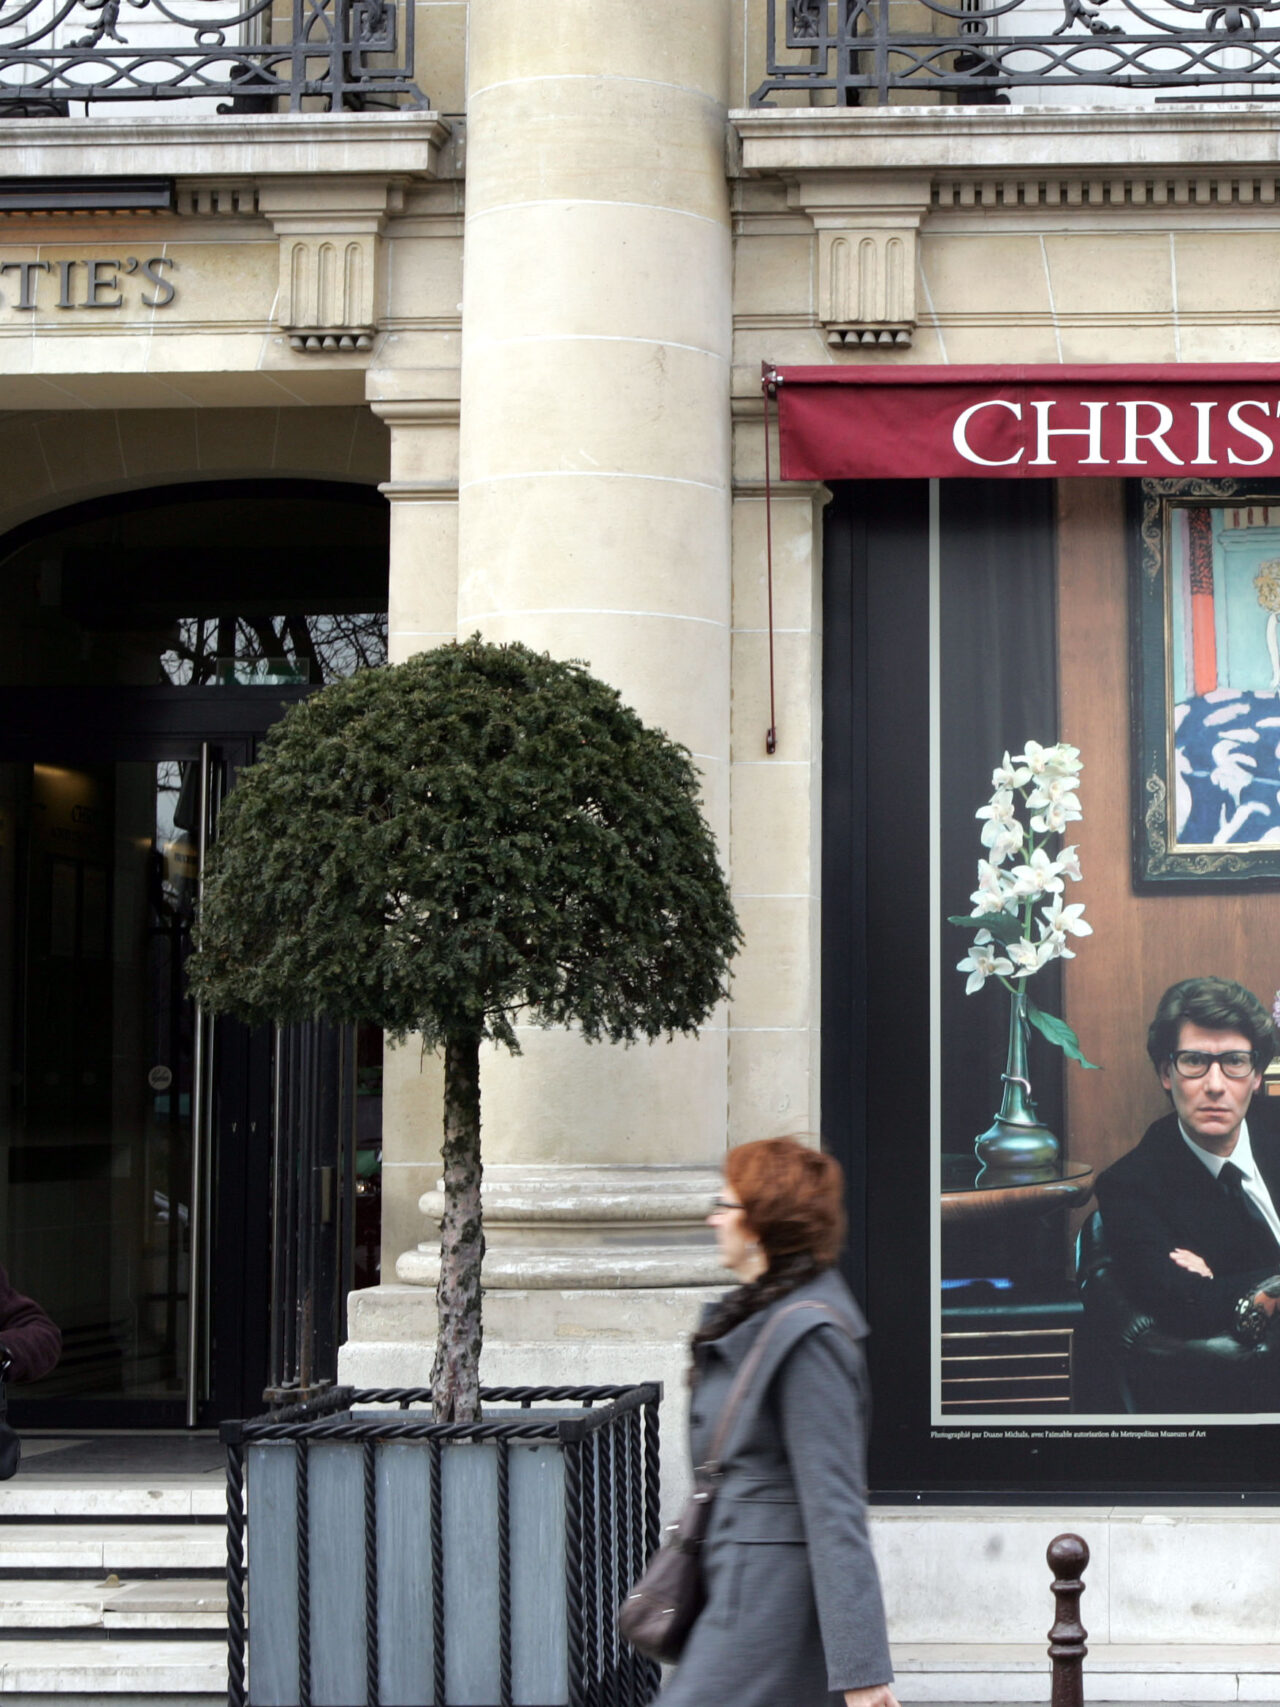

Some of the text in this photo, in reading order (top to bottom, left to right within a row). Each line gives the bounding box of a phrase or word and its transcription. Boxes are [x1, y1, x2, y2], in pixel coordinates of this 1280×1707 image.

[0, 256, 176, 310] TIE'S
[1073, 1430, 1110, 1438] autorisation
[1120, 1430, 1159, 1439] Metropolitan
[1160, 1430, 1188, 1438] Museum
